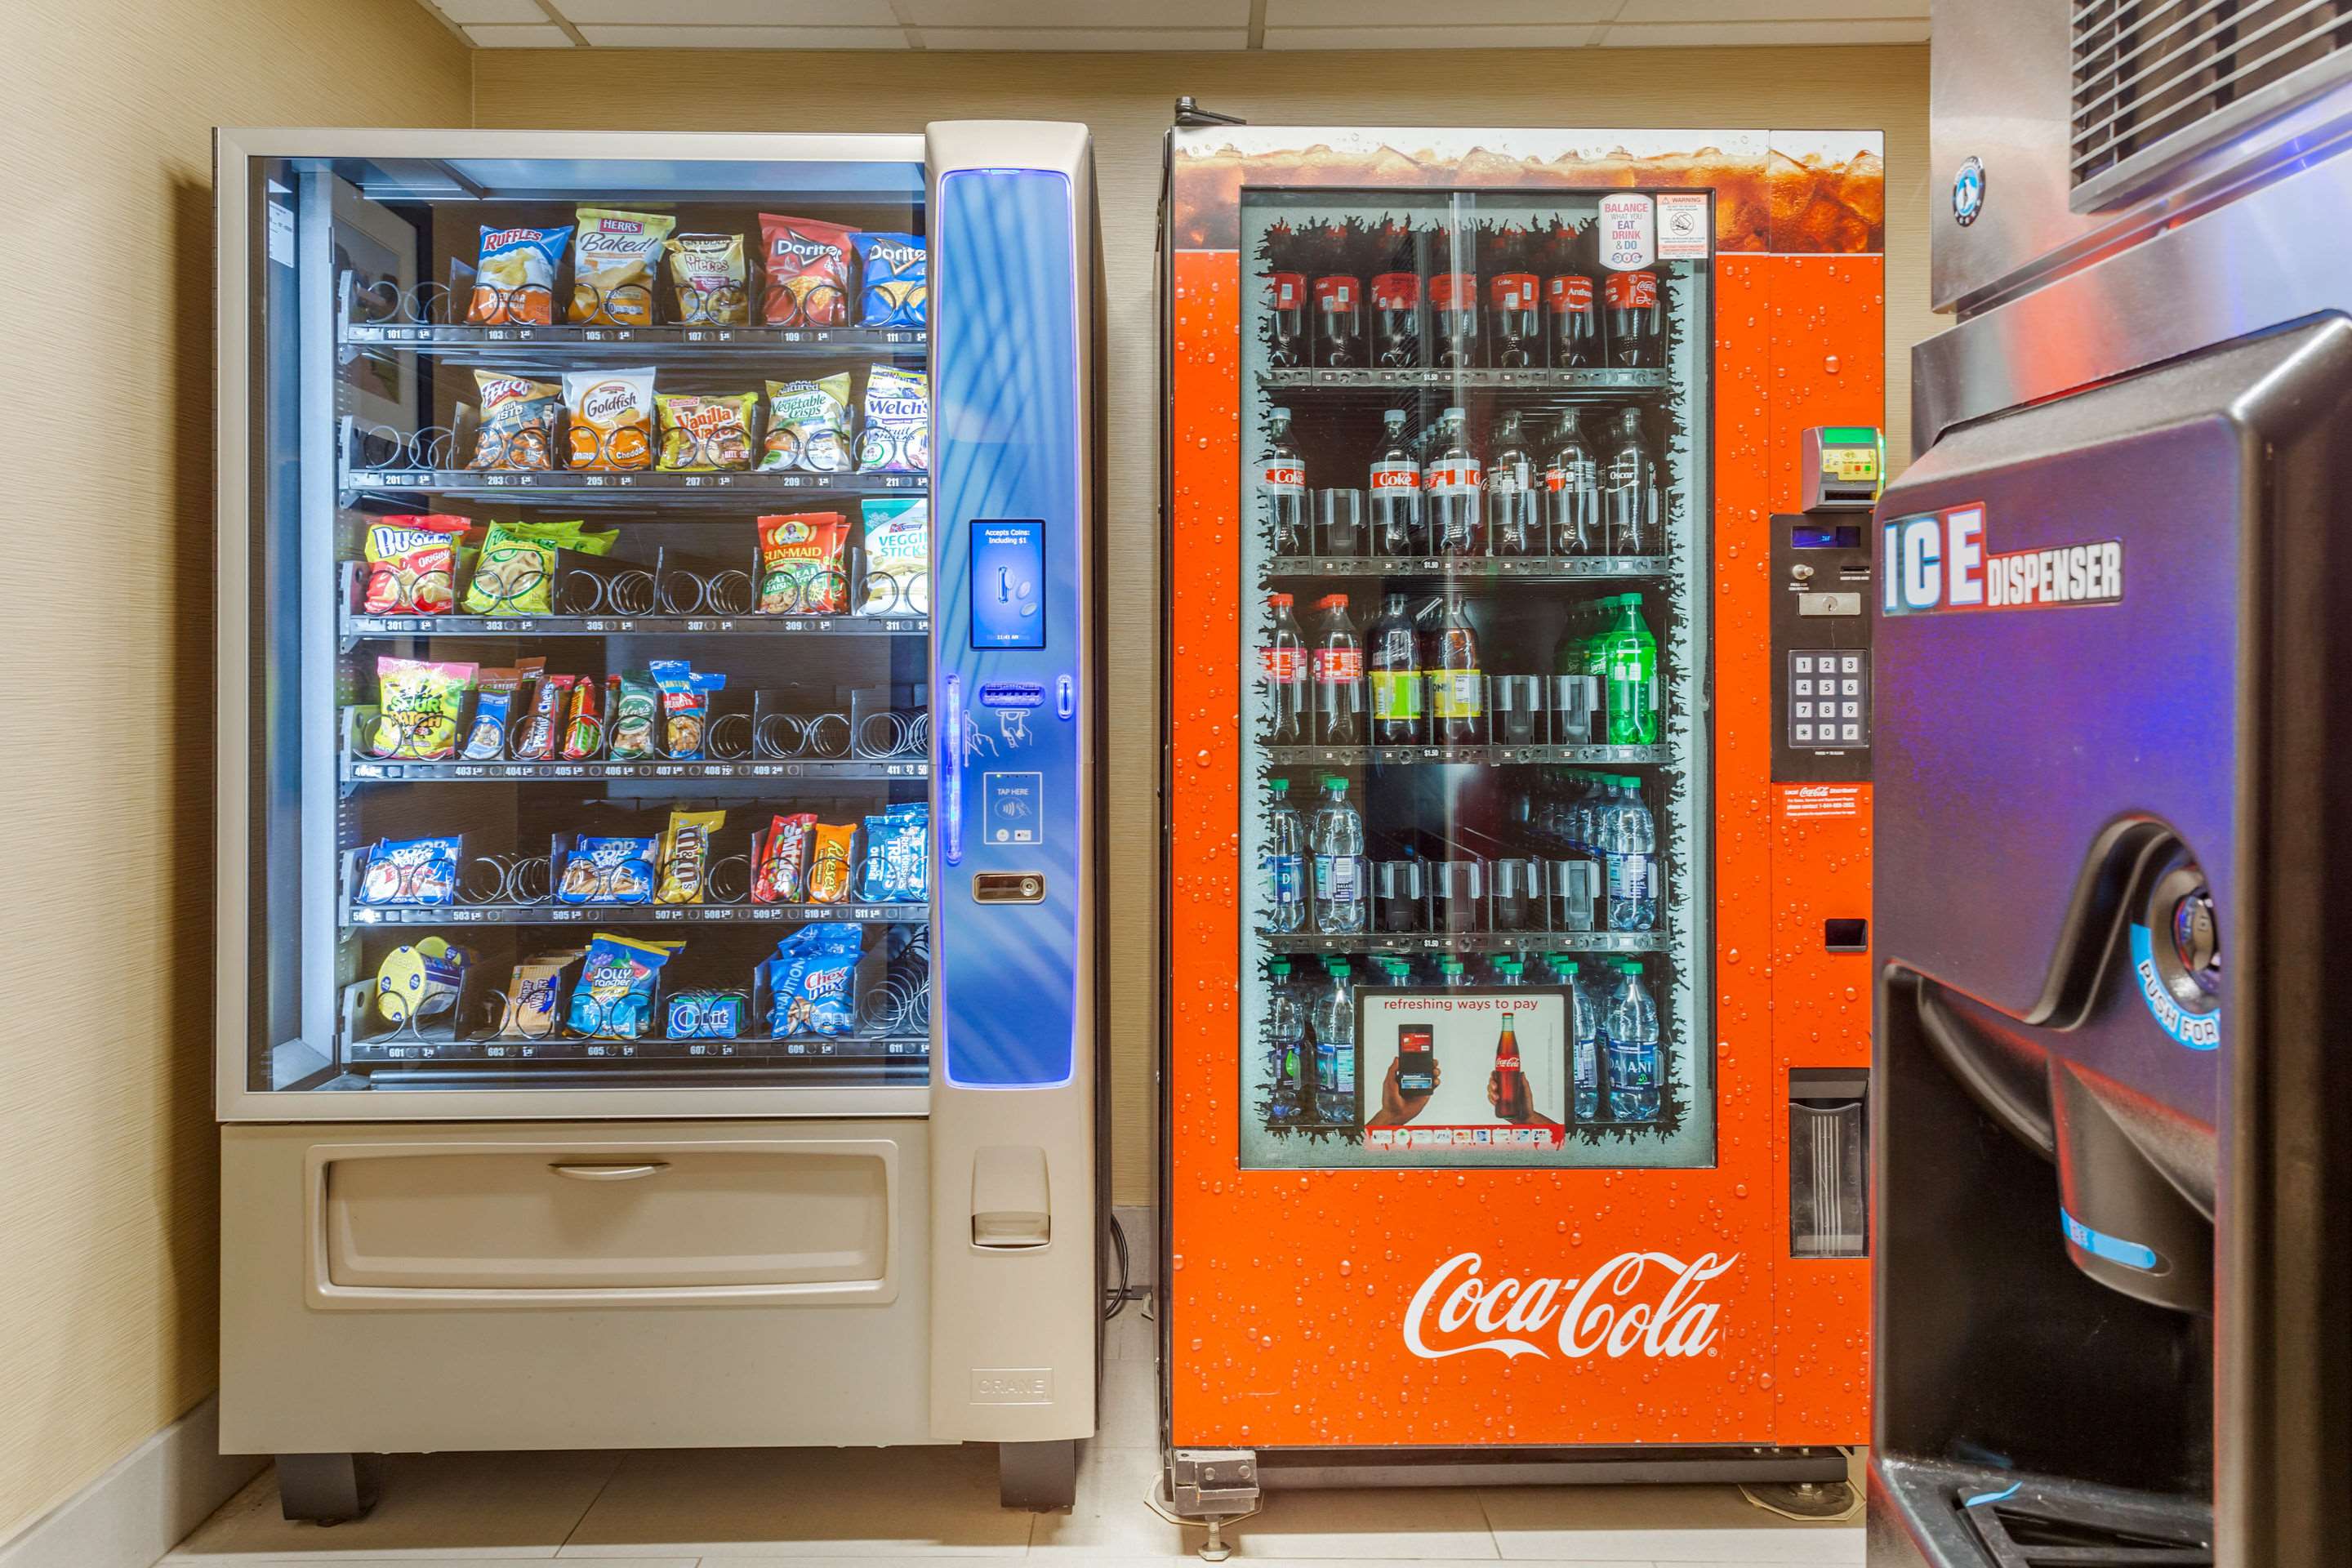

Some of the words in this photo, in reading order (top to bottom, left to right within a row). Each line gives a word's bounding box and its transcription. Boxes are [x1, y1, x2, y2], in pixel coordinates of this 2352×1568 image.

[1605, 203, 1648, 212] BALANCE
[604, 220, 638, 231] HERR'S
[1618, 220, 1634, 229] EAT
[1612, 231, 1641, 239] DRINK
[483, 229, 542, 252] RUFFLES
[580, 232, 658, 252] Baked!
[1616, 241, 1623, 249] &
[1624, 241, 1637, 249] DO
[778, 240, 841, 262] Doritos
[870, 246, 925, 261] Dorito
[685, 254, 728, 273] Pieces
[387, 330, 400, 339] 101
[489, 331, 503, 339] 103
[586, 332, 600, 340] 105
[785, 333, 799, 341] 109
[887, 333, 898, 342] 111
[588, 392, 636, 416] Goldfish
[772, 395, 826, 415] Vegetable
[790, 407, 821, 418] Crisps
[675, 406, 732, 429] Vanilla
[617, 447, 645, 459] Cheddar
[386, 476, 400, 484] 201
[488, 476, 503, 485] 203
[587, 477, 602, 485] 205
[686, 477, 700, 485] 207
[1276, 470, 1304, 483] Coke
[1380, 472, 1411, 485] Coke
[784, 478, 800, 486] 209
[886, 478, 898, 486] 211
[880, 533, 928, 546] VEGGI
[764, 547, 822, 562] SUN-MAID
[1885, 509, 1983, 610] ICE
[1987, 541, 2121, 606] DISPENSER
[387, 621, 402, 630] 301
[487, 621, 502, 630] 303
[886, 621, 899, 630] 311
[538, 683, 555, 712] Chews
[534, 716, 549, 747] Peanut
[456, 767, 470, 775] 403
[506, 767, 521, 775] 404
[705, 767, 719, 775] 408
[754, 766, 769, 774] 409
[887, 765, 900, 774] 411
[453, 911, 469, 920] 503
[754, 910, 769, 918] 509
[804, 910, 819, 918] 510
[855, 910, 867, 918] 511
[595, 967, 634, 980] JOLLY
[805, 967, 849, 989] Chex
[1384, 998, 1452, 1010] refreshing
[1458, 1000, 1490, 1010] ways
[1496, 999, 1509, 1009] to
[1514, 1000, 1538, 1010] pay
[2139, 962, 2178, 1031] PUSH
[2182, 1019, 2216, 1042] FOR
[390, 1049, 403, 1057] 601
[488, 1048, 503, 1056] 603
[588, 1047, 604, 1055] 605
[690, 1046, 705, 1054] 607
[788, 1045, 804, 1054] 609
[889, 1045, 902, 1053] 611
[1610, 1058, 1650, 1073] DAANI
[1403, 1252, 1740, 1359] Coca-Cola
[980, 1380, 1045, 1393] CRANE
